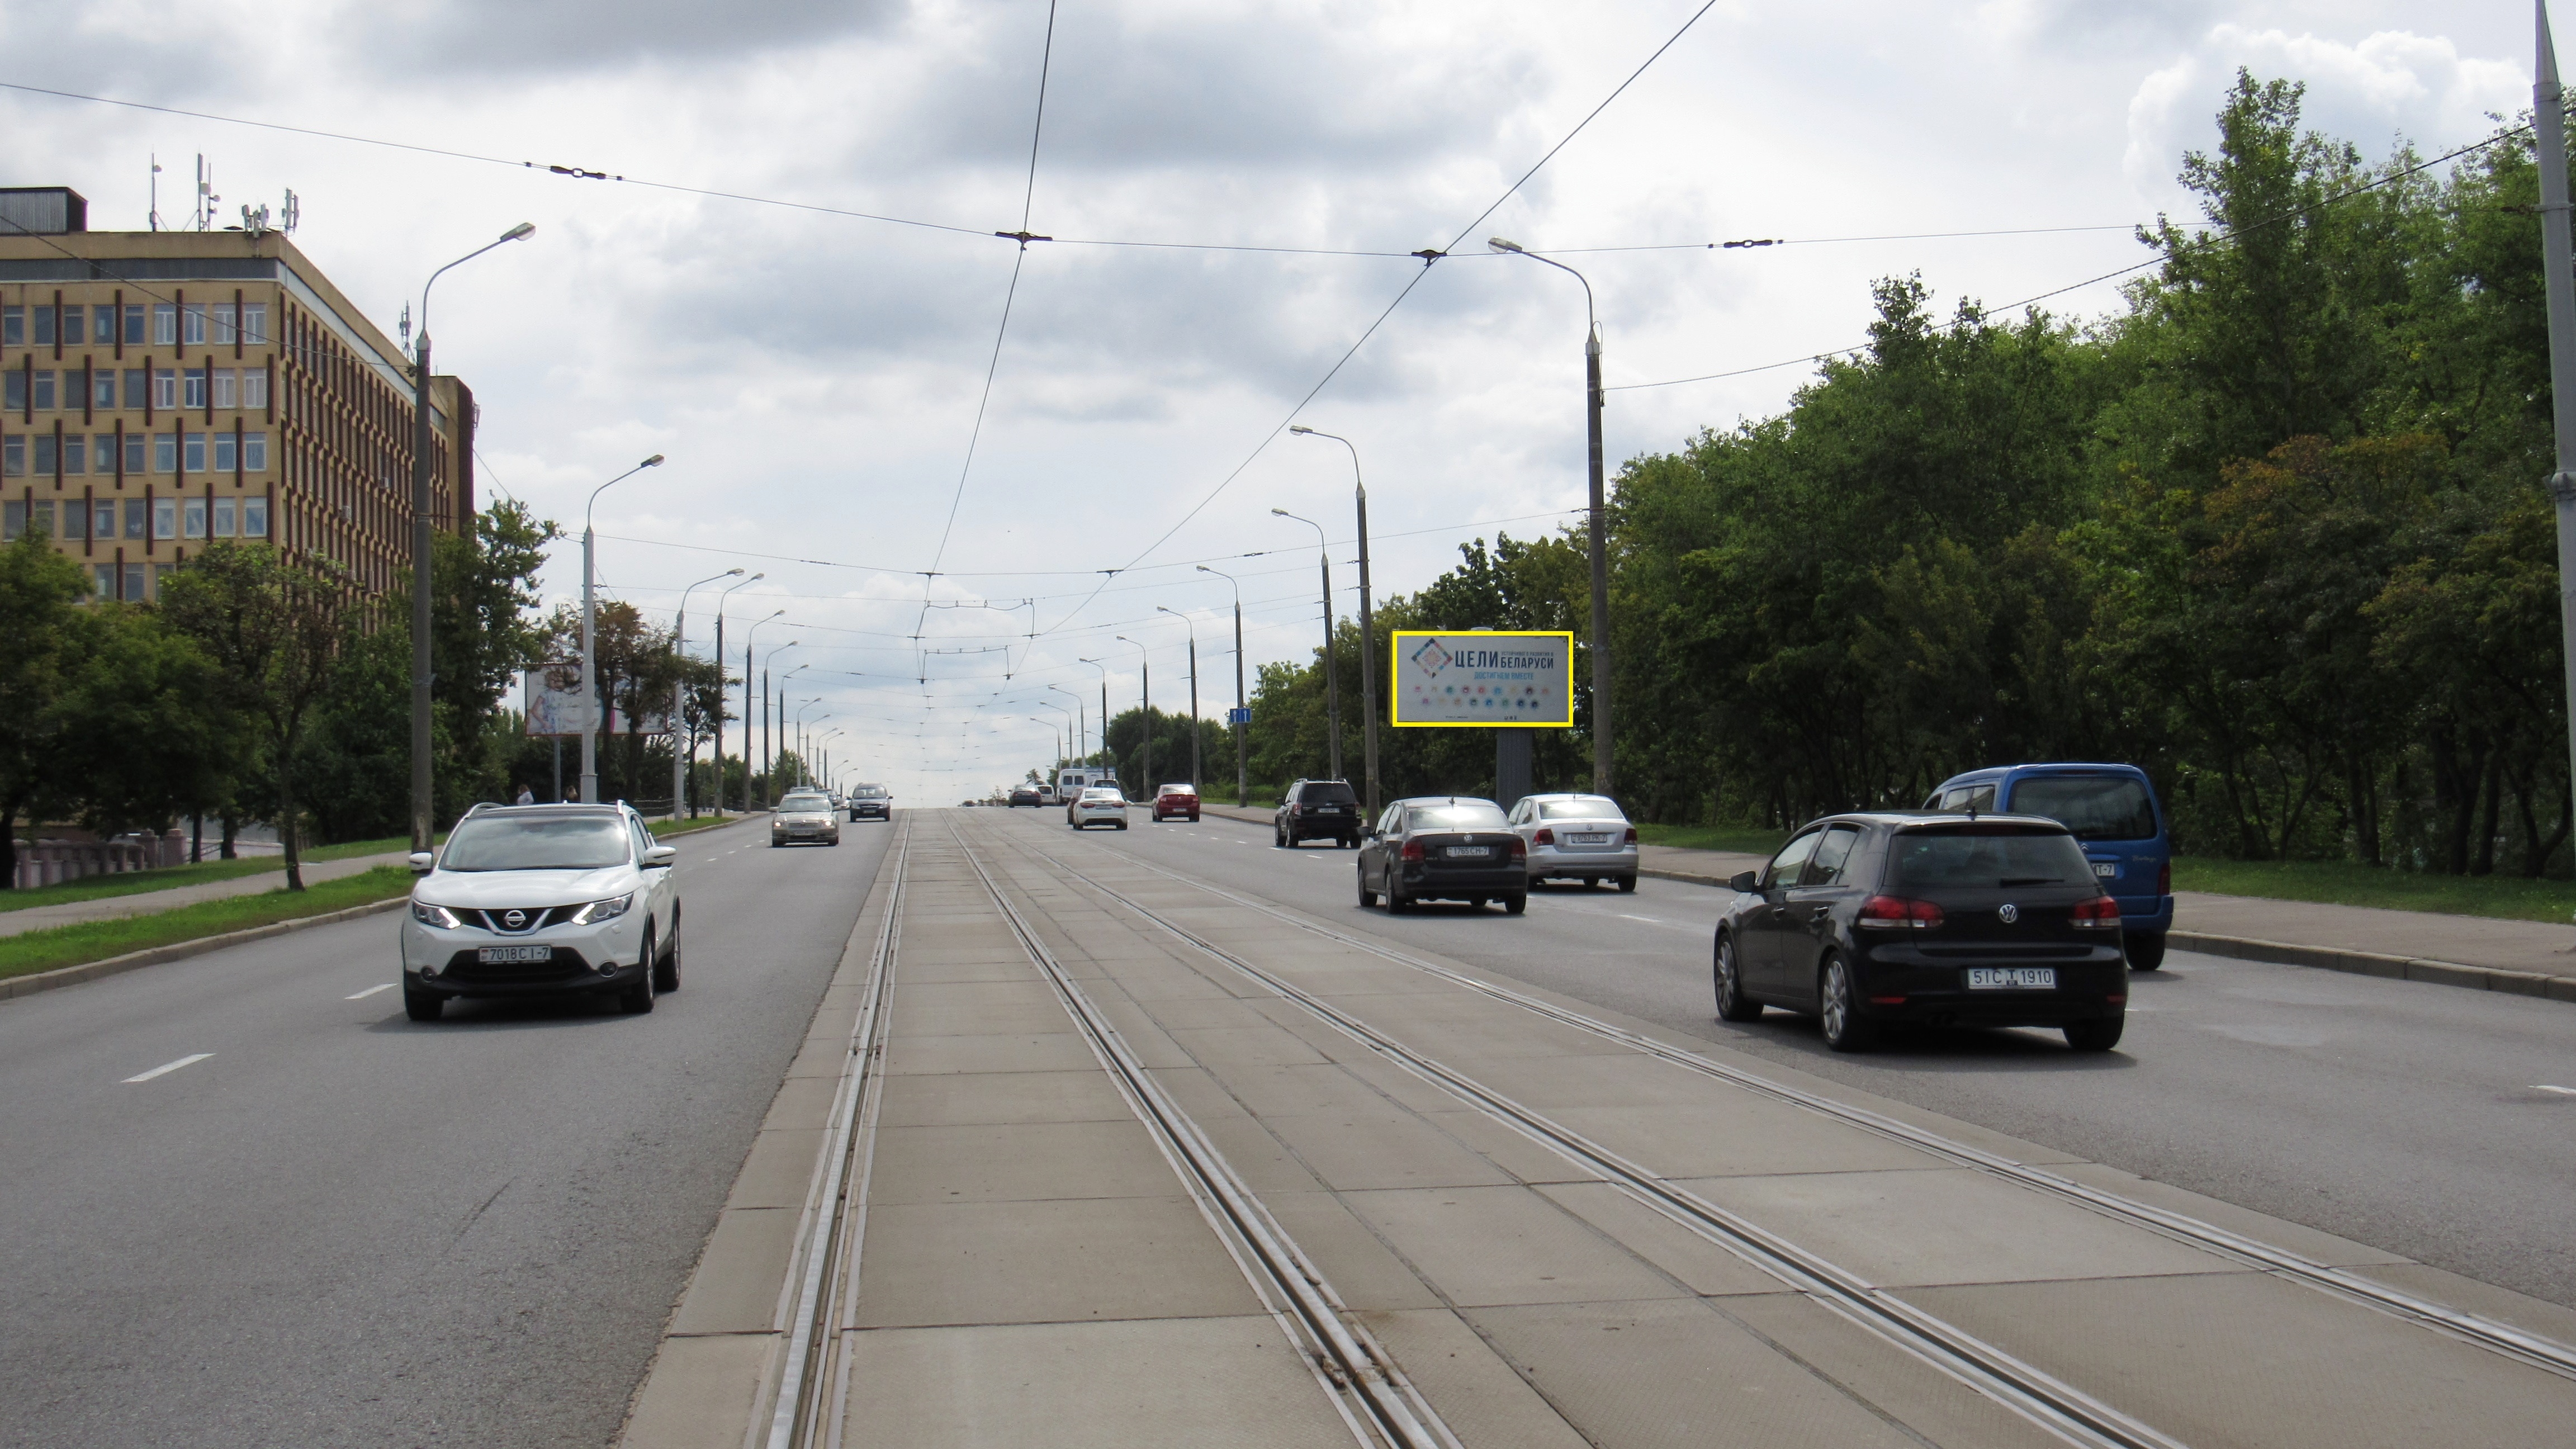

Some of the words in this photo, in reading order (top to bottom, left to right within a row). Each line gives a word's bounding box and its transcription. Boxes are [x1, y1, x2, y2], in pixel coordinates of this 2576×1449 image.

[1455, 650, 1498, 668] ЦЕЛИ
[1500, 657, 1554, 669] БЕЛАРУСИ
[1511, 672, 1534, 680] ВМЕСТЕ
